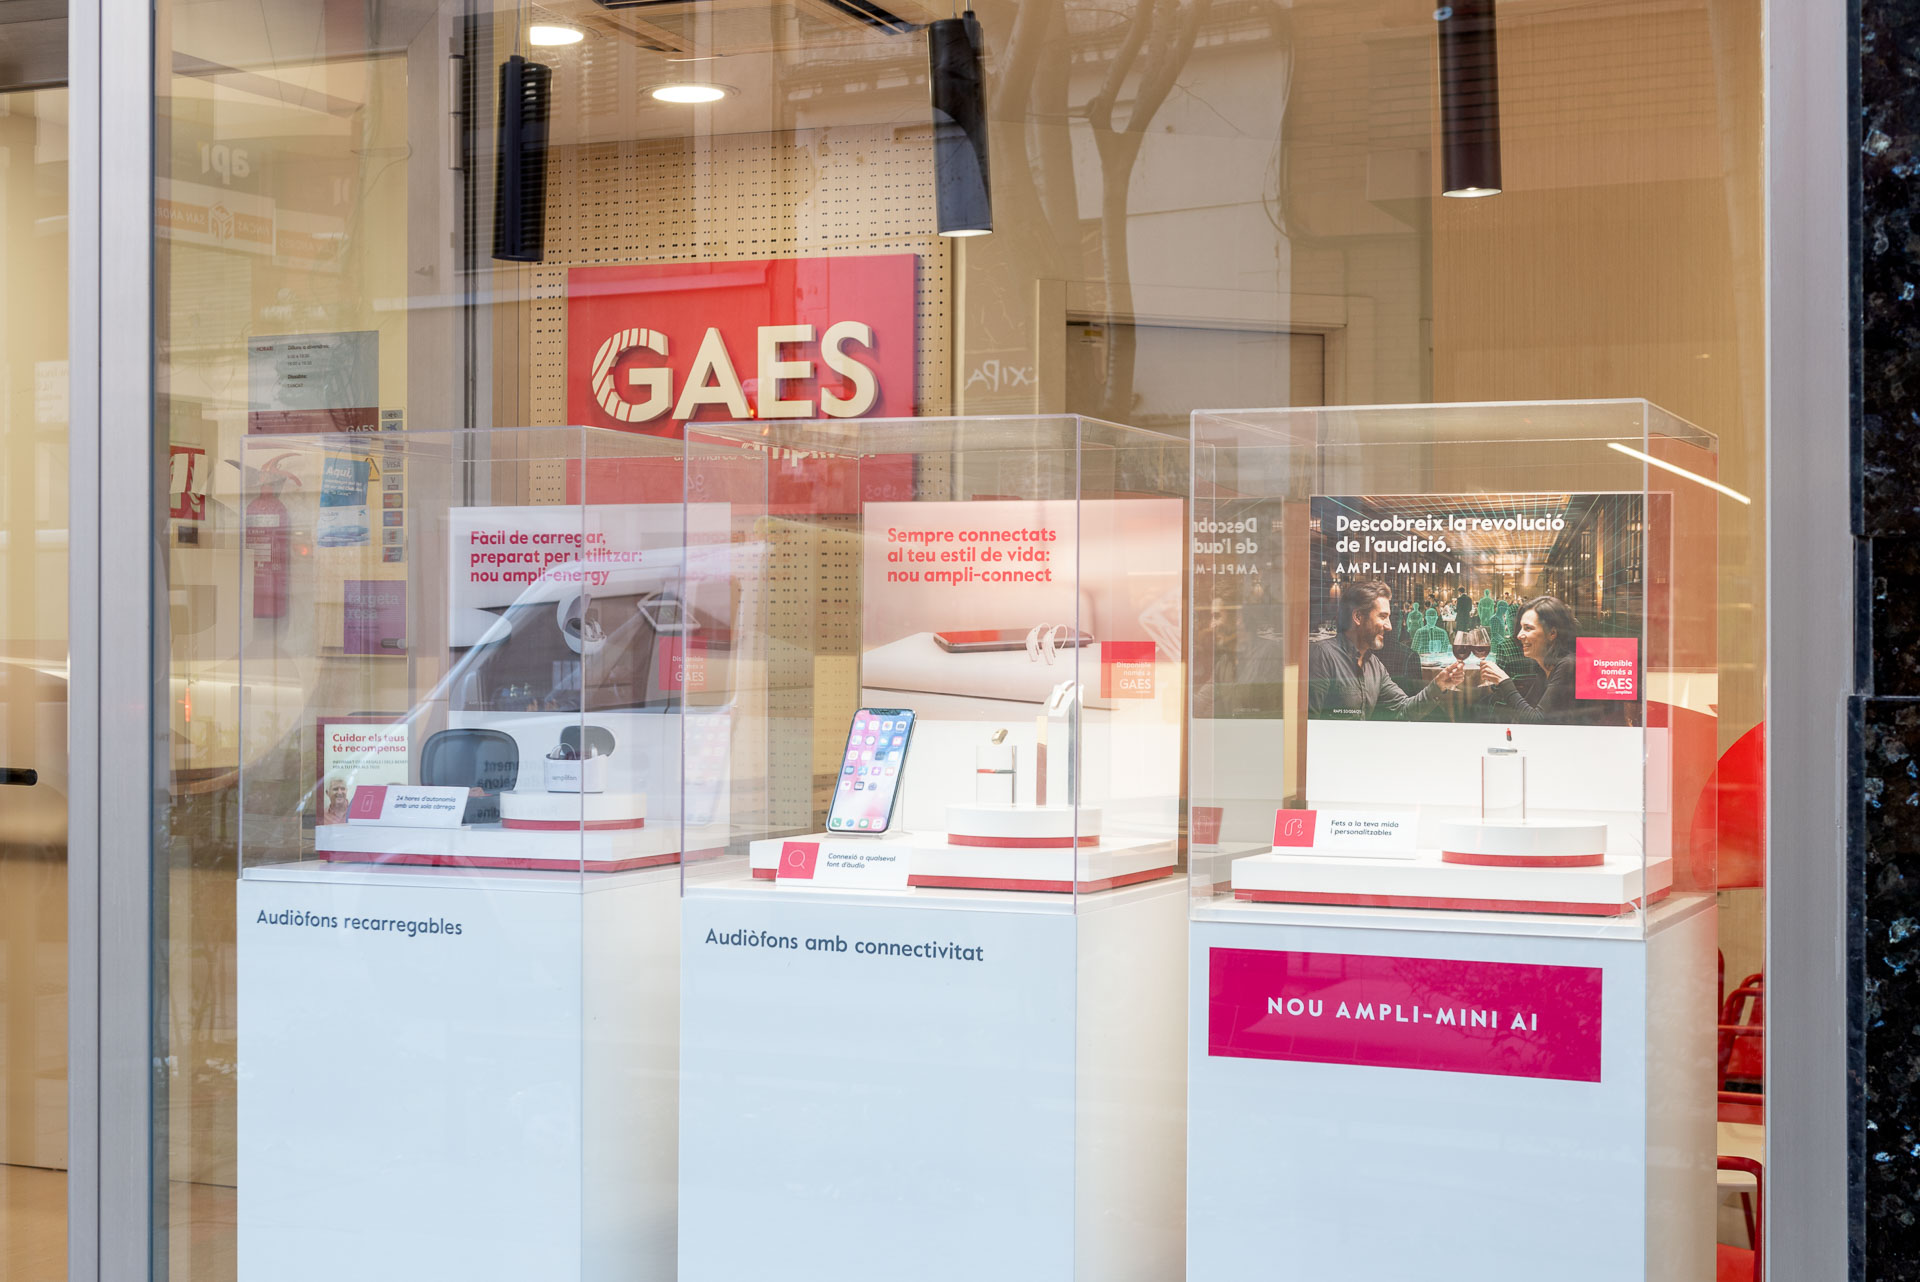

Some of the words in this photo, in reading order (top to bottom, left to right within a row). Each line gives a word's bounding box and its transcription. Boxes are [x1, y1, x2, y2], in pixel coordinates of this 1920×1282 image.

[591, 321, 880, 423] GAES
[1336, 515, 1444, 532] Descobreix
[1448, 514, 1467, 531] la
[1472, 513, 1565, 532] revolució
[470, 530, 506, 545] Fàcil
[509, 530, 529, 545] de
[532, 533, 606, 548] carregar,
[887, 527, 954, 546] Sempre
[958, 527, 1057, 542] connectats
[1335, 536, 1360, 553] de
[470, 550, 540, 567] preparat
[544, 553, 570, 567] per
[887, 547, 903, 562] al
[907, 549, 936, 562] teu
[940, 546, 976, 562] estil
[980, 546, 1003, 562] de
[1007, 546, 1050, 562] vida:
[887, 569, 919, 582] nou
[924, 566, 1052, 586] ampli-connect
[1335, 562, 1436, 574] AMPLI-MINI
[1443, 562, 1461, 574] AI
[470, 570, 499, 582] nou
[502, 567, 610, 586] ampli-energy
[347, 592, 399, 608] targeta
[347, 609, 377, 620] rosa
[1116, 661, 1151, 669] Disponible
[1593, 659, 1632, 668] Disponible
[1119, 678, 1151, 690] GAES
[1596, 677, 1633, 690] GAES
[332, 733, 366, 742] Cuidar
[368, 733, 382, 742] els
[384, 734, 405, 742] teus
[332, 743, 343, 752] té
[345, 745, 406, 754] recompensa
[433, 803, 456, 811] càrrega
[1334, 828, 1392, 836] personalitzables
[828, 852, 858, 860] Connexió
[841, 861, 865, 869] d'àudio
[256, 909, 338, 928] Audiòfons
[344, 916, 463, 937] recarregables
[705, 928, 798, 949] Audiòfons
[805, 935, 848, 952] amb
[854, 940, 984, 962] connectivitat
[1267, 996, 1323, 1017] NOU
[1336, 1001, 1498, 1029] AMPLI-MINI
[1510, 1012, 1537, 1031] AI
